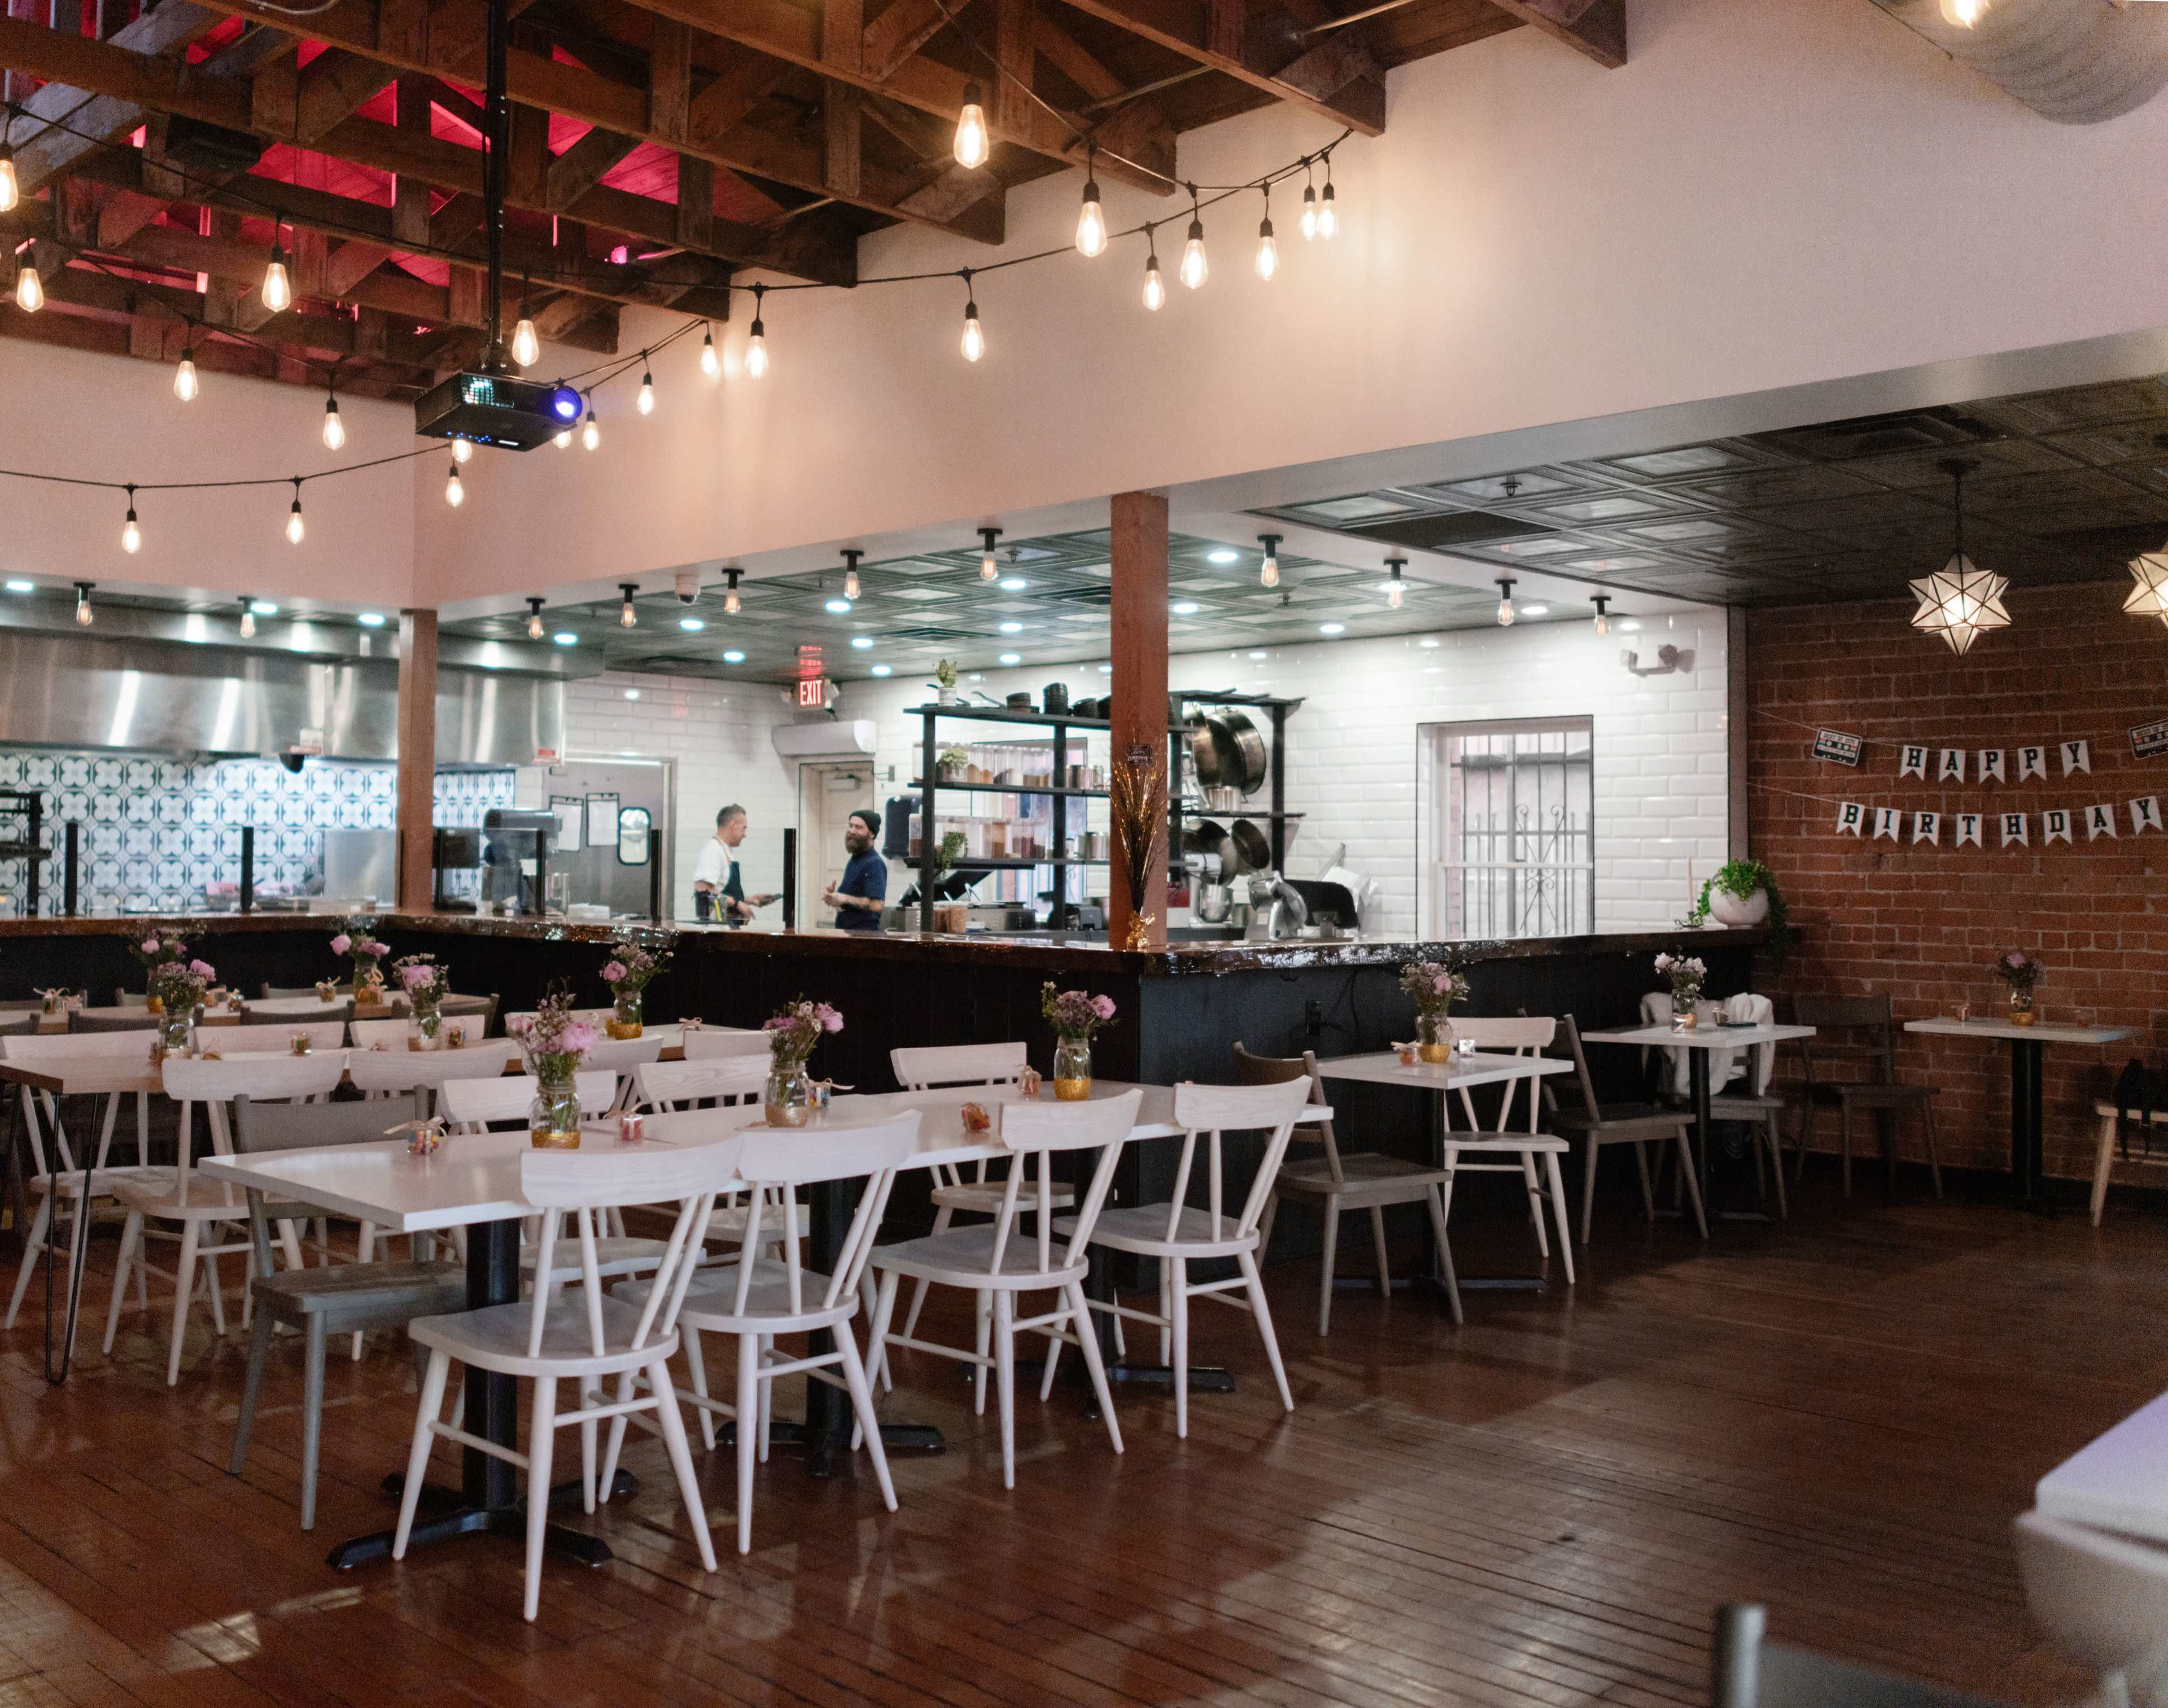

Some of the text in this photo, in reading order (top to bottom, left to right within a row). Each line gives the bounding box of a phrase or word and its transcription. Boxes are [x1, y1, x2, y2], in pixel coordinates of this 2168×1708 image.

[799, 679, 822, 705] EXIT
[1906, 742, 2080, 771] HAPPY
[1843, 798, 2150, 835] BIRTHDAY
